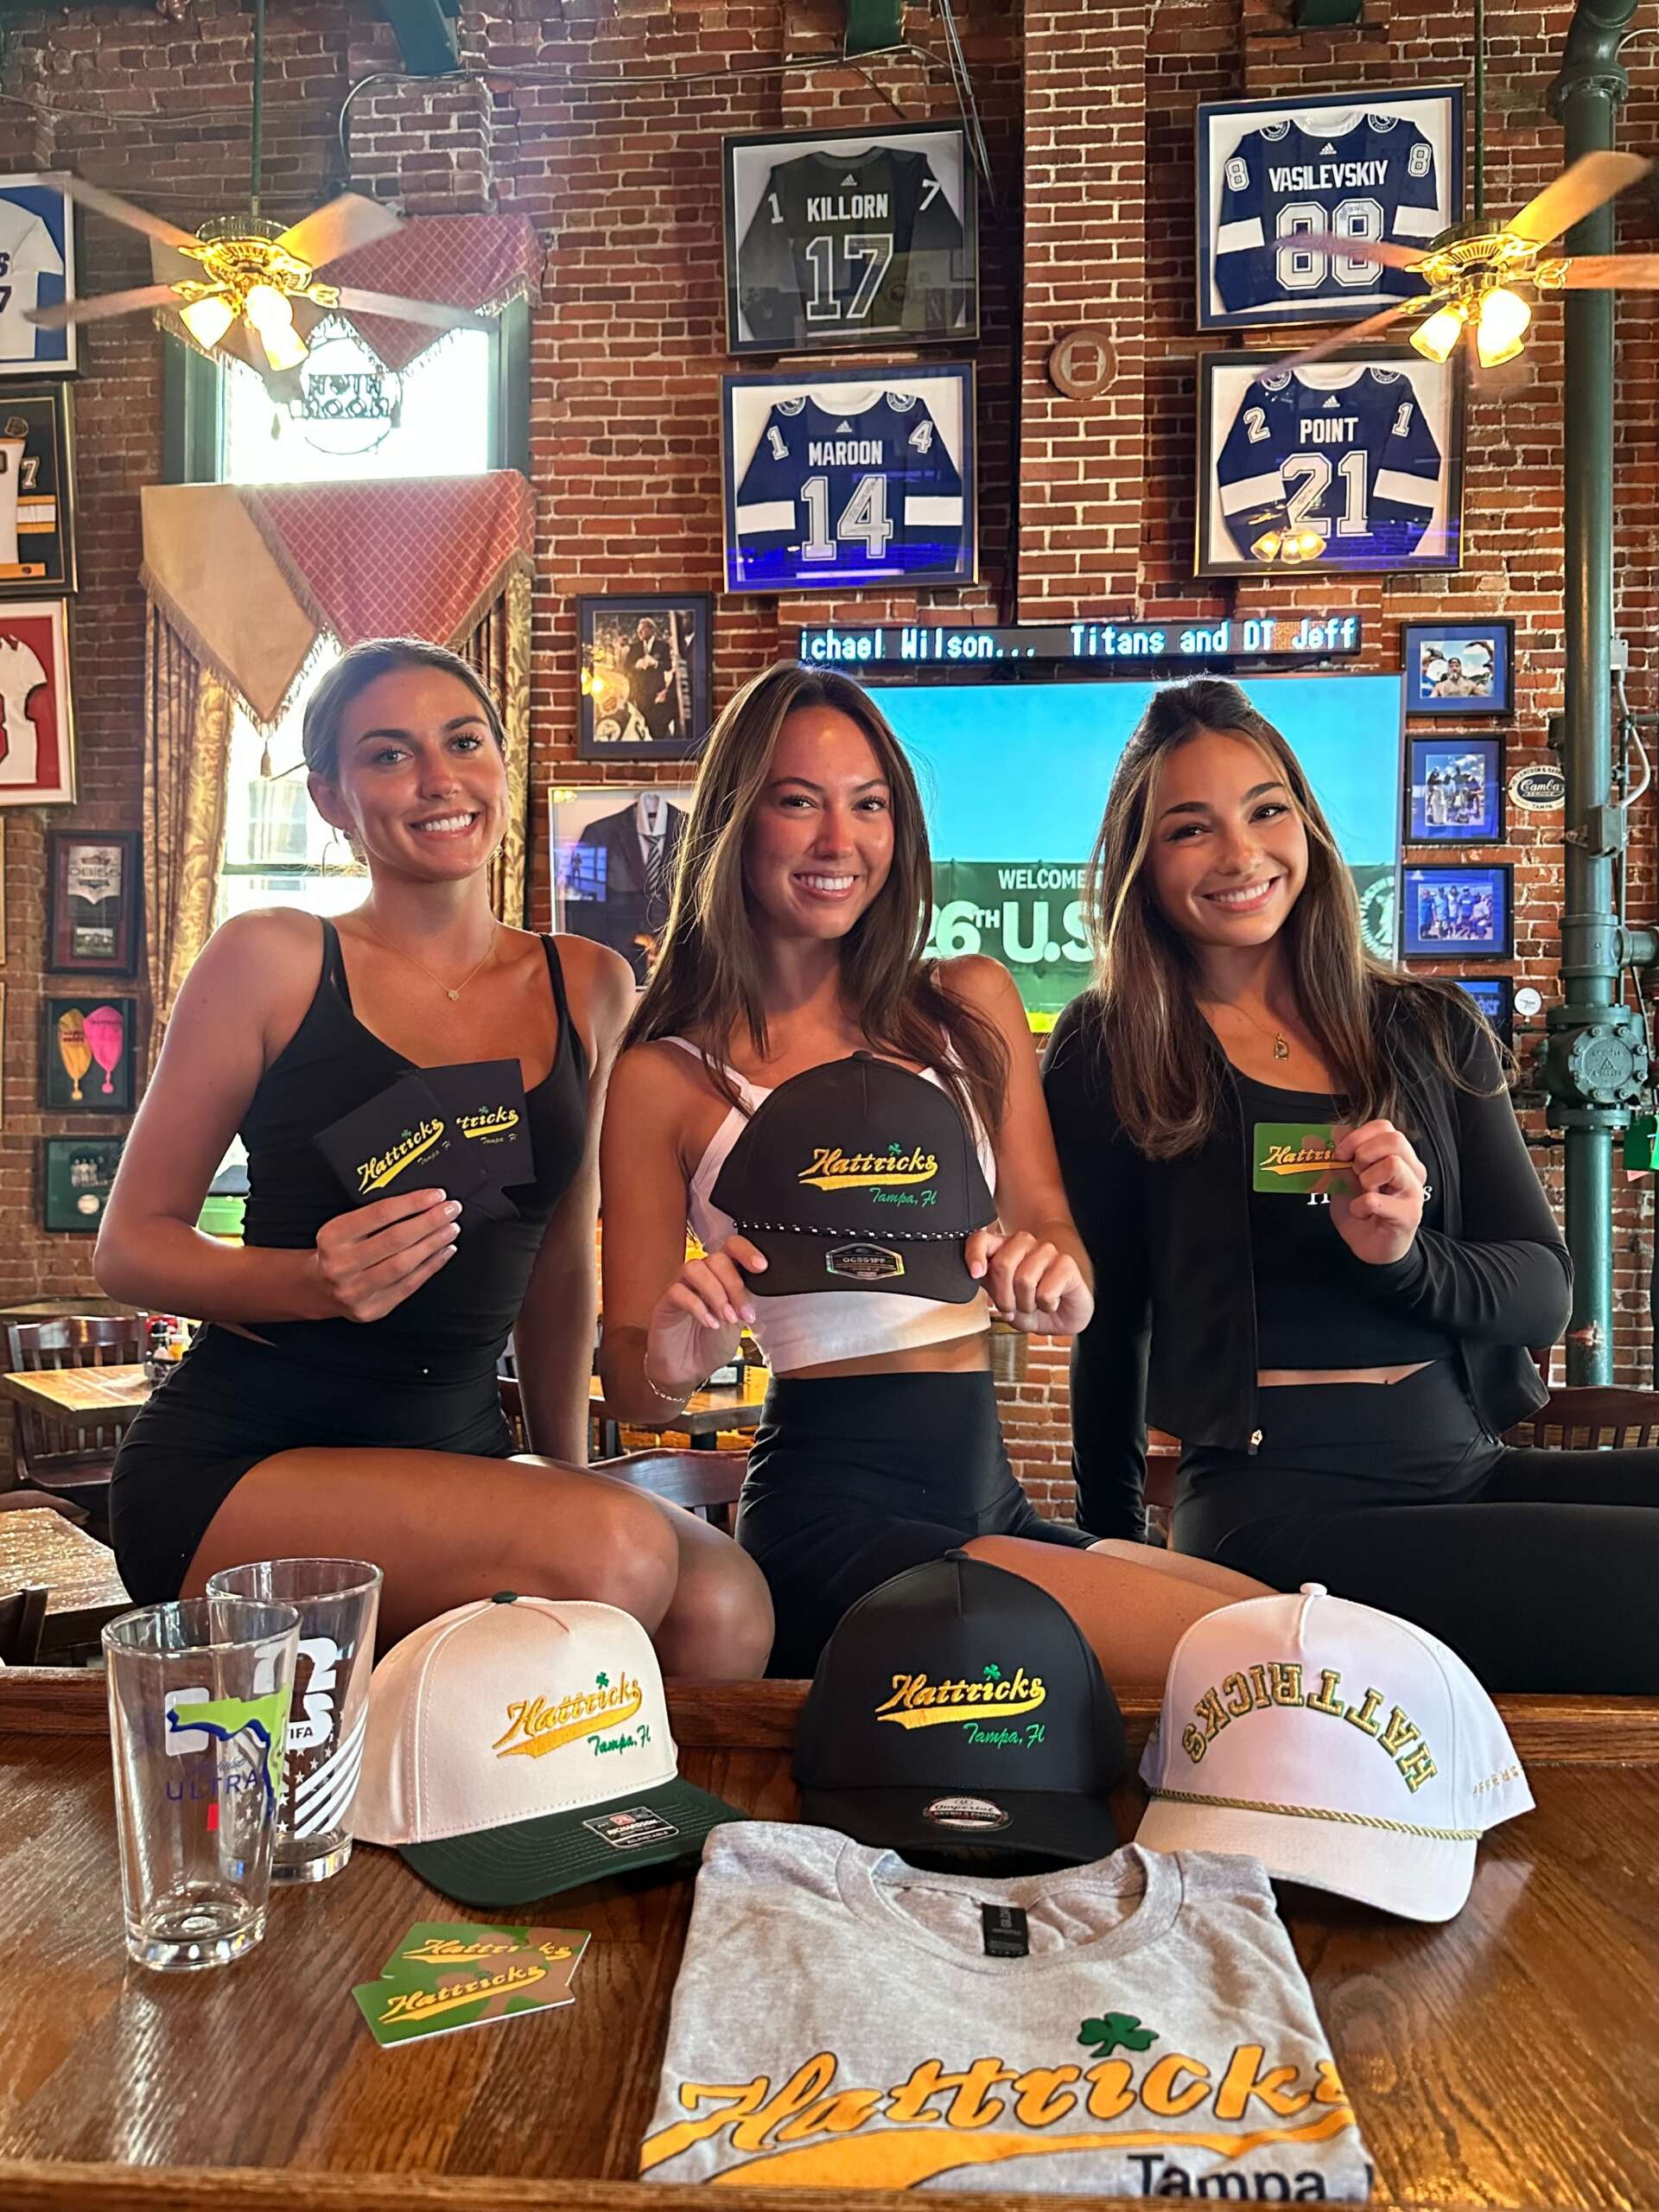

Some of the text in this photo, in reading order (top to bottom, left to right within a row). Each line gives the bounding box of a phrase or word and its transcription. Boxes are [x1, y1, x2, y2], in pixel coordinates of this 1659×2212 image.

[1225, 156, 1249, 192] 8
[1268, 160, 1389, 192] VASILEVSKIY
[1408, 143, 1431, 177] 8
[768, 193, 784, 224] 1
[807, 194, 888, 222] KILLORN
[919, 179, 940, 211] 7
[1276, 198, 1384, 290] 88
[806, 233, 893, 321] 17
[908, 420, 933, 454] 4
[1243, 407, 1271, 443] 2
[1300, 417, 1358, 443] POINT
[1391, 403, 1414, 437] 1
[767, 426, 789, 461] 1
[809, 440, 883, 467] MAROON
[22, 456, 40, 489] 7
[1280, 450, 1373, 538] 21
[801, 474, 893, 561] 14
[801, 627, 882, 659] ichael
[1071, 625, 1165, 656] Titans
[1180, 620, 1230, 652] and
[1243, 619, 1274, 651] DT
[1292, 617, 1355, 651] Jeff
[998, 868, 1084, 890] WELCOME
[357, 1118, 443, 1191] Hattricks
[798, 1147, 937, 1177] Hattricks
[869, 1187, 918, 1207] Tampa,
[874, 1668, 1046, 1713] Hattricks
[493, 1672, 642, 1749] Hattricks
[290, 1726, 313, 1739] IFA
[963, 1723, 1023, 1748] Tampa,
[1181, 1662, 1438, 1795] HATTRICKS
[166, 1770, 258, 1801] ULTRA
[378, 1966, 546, 2022] Hattricks
[640, 2044, 1350, 2174] Hattricks
[1127, 2153, 1326, 2201] Tampa
